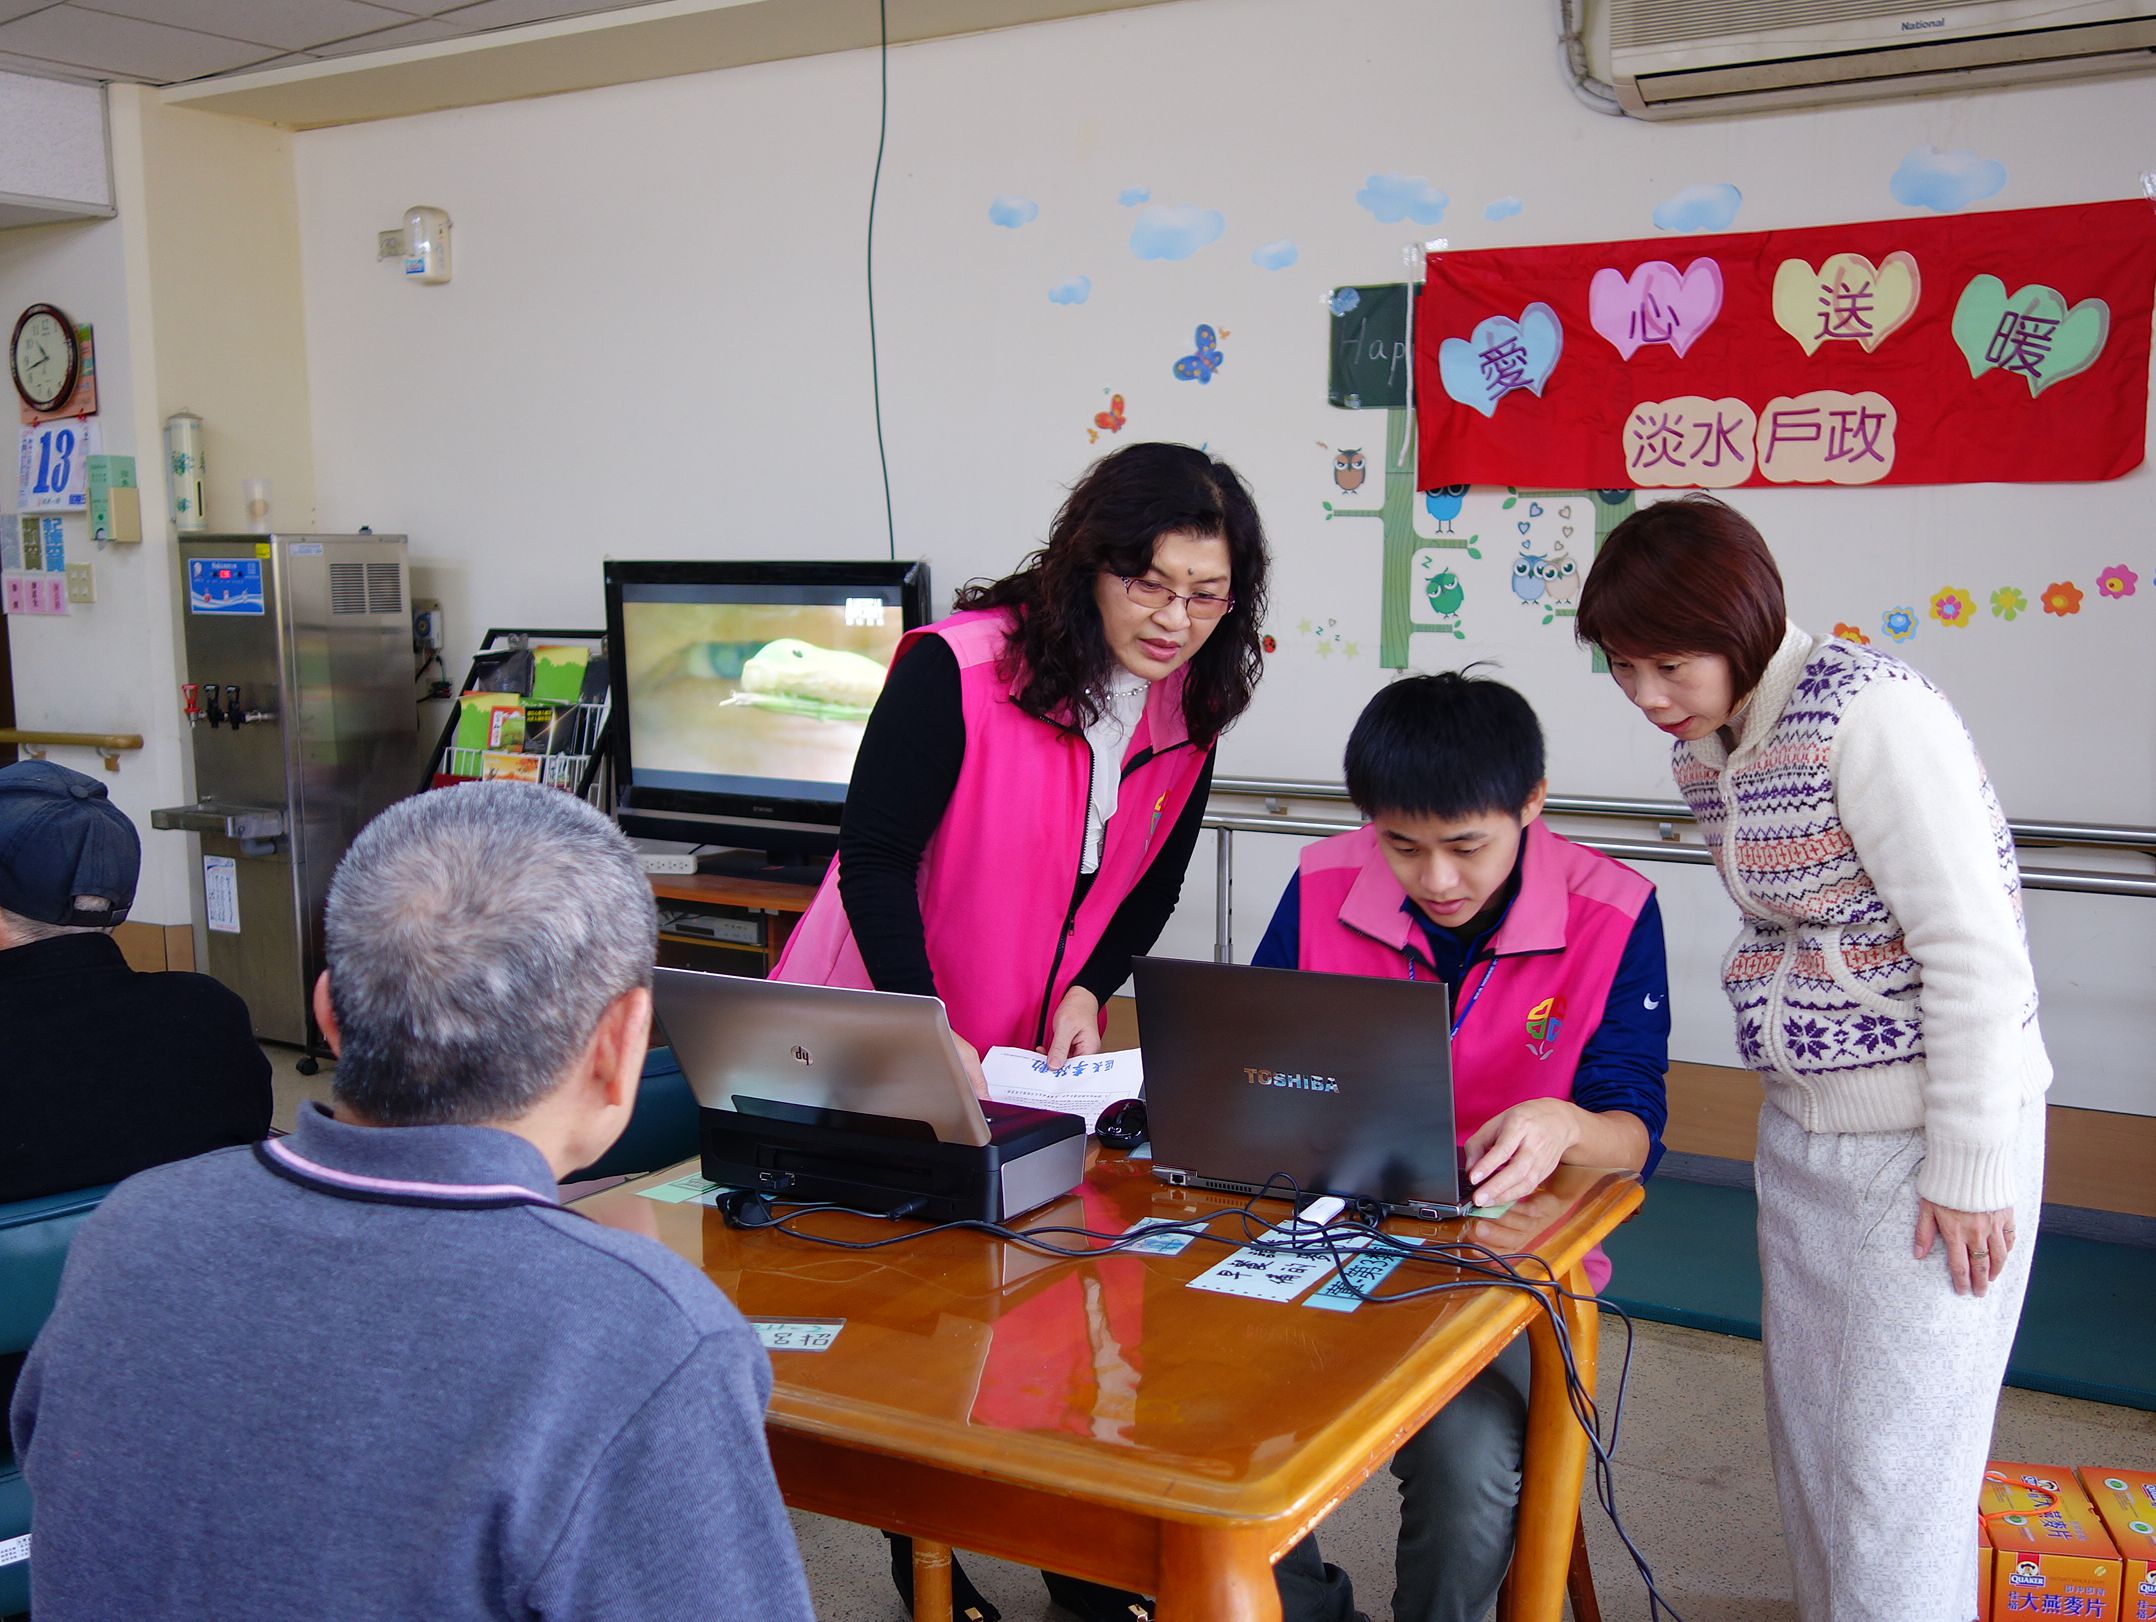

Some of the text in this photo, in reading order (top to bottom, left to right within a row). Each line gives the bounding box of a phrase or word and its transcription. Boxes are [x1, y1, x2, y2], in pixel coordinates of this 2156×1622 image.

[1901, 17, 1945, 31] National
[1477, 281, 2061, 401] 愛 心 送 暖
[33, 428, 76, 494] 13
[1243, 1067, 1340, 1094] TOSHIBA
[2010, 1574, 2045, 1586] QUAKER
[2018, 1591, 2107, 1618] 大燕麥片
